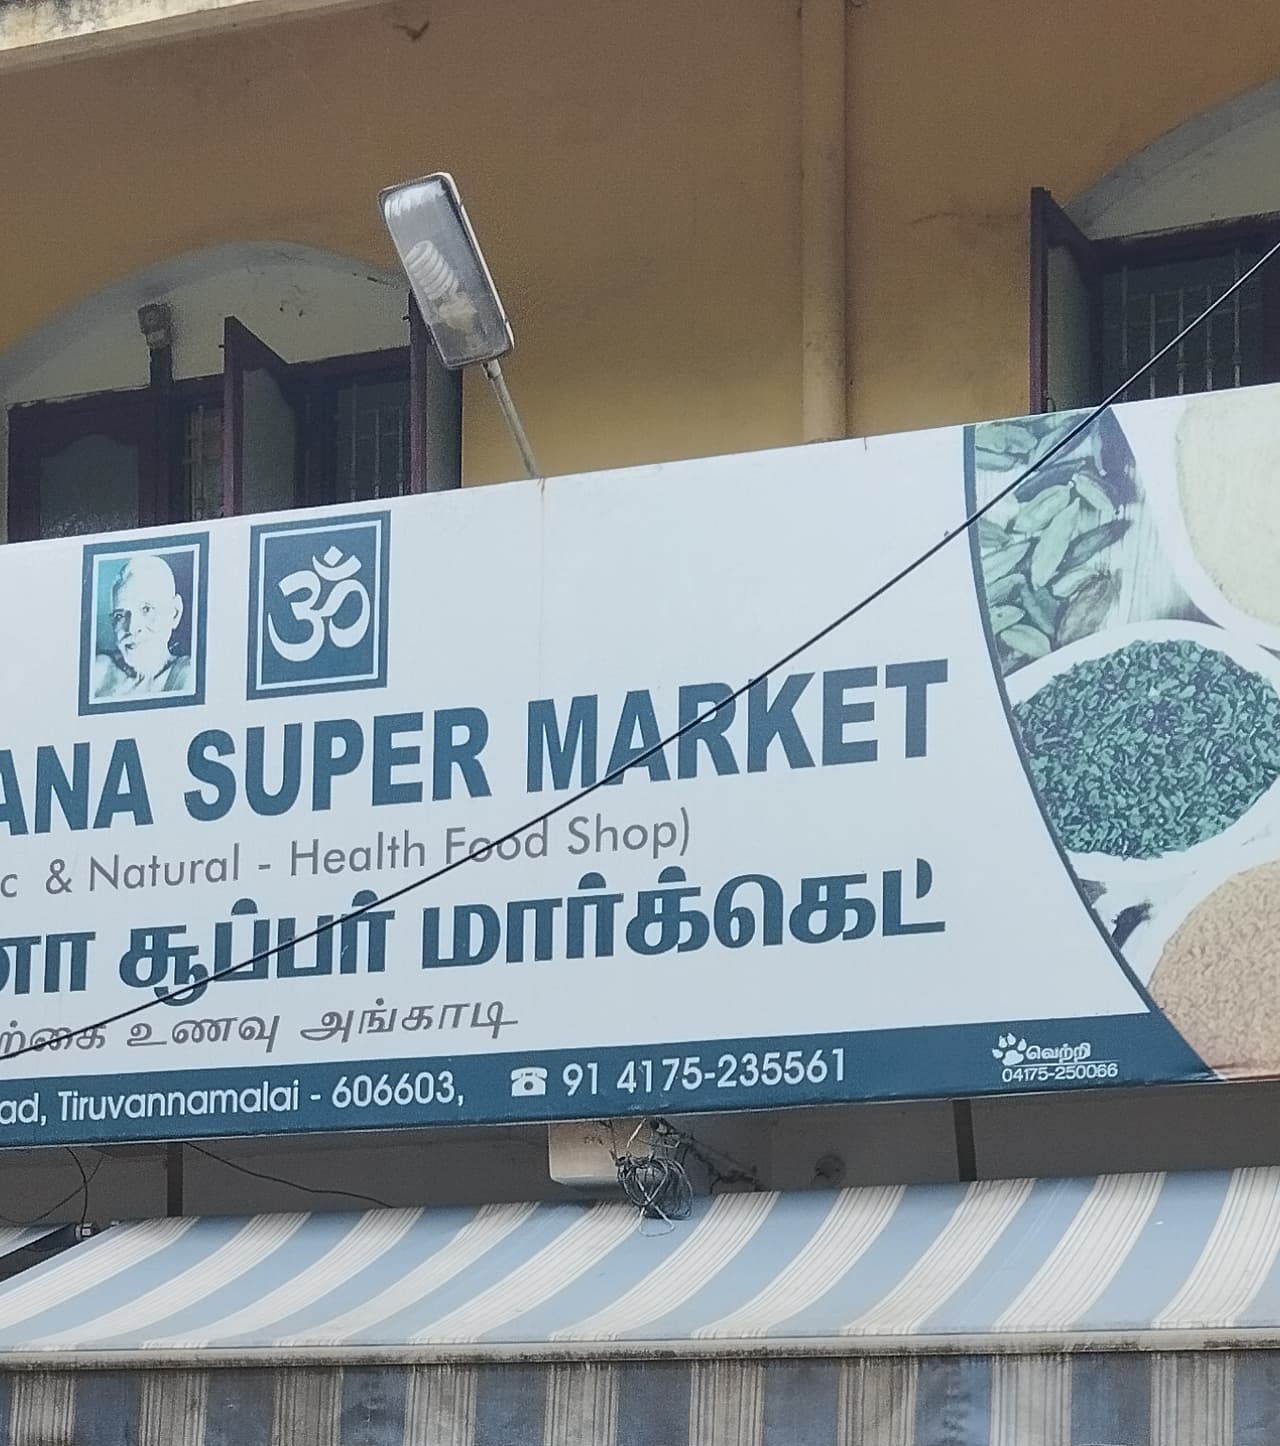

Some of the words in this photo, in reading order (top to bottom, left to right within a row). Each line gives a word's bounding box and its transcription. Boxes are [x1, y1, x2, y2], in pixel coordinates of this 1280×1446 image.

[184, 706, 492, 822] SUPER
[527, 658, 949, 794] MARKET
[44, 858, 74, 895] &
[89, 843, 241, 893] Natural
[291, 828, 427, 878] Health
[445, 819, 550, 864] Food
[567, 807, 691, 860] Shop)
[119, 888, 396, 1008] சூப்பர்
[421, 857, 947, 970] மார்க்கெட்
[126, 1012, 281, 1054] உணவு
[300, 997, 520, 1044] அங்காடி
[58, 1080, 300, 1123] Tiruvannamalai
[331, 1069, 465, 1110] 606603,
[562, 1060, 601, 1098] 91
[615, 1047, 847, 1094] 4175-235561
[1001, 1062, 1119, 1083] 04175-250066
